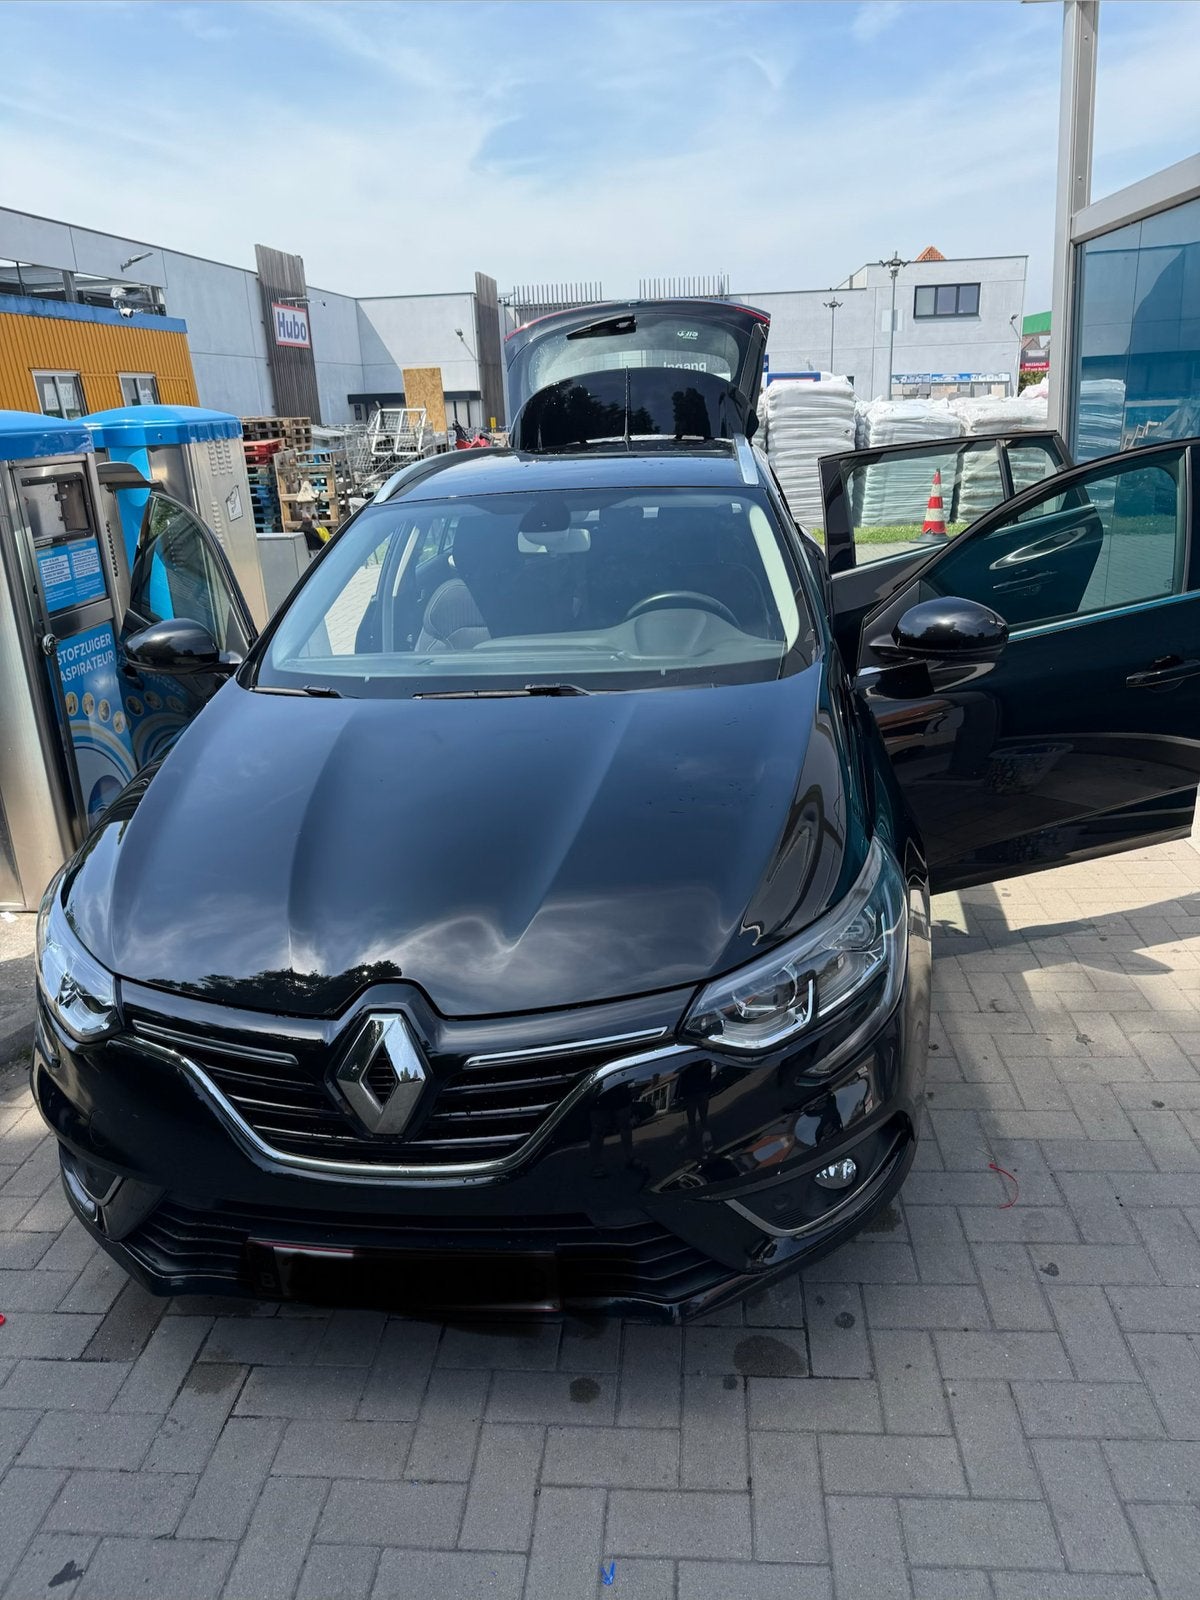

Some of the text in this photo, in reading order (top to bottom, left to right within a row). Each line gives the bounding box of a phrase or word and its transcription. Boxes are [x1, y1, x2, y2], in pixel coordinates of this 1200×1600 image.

[277, 311, 306, 341] Hubo
[57, 633, 112, 665] STOFZUIGER
[60, 650, 114, 682] ASPIRATEUR
